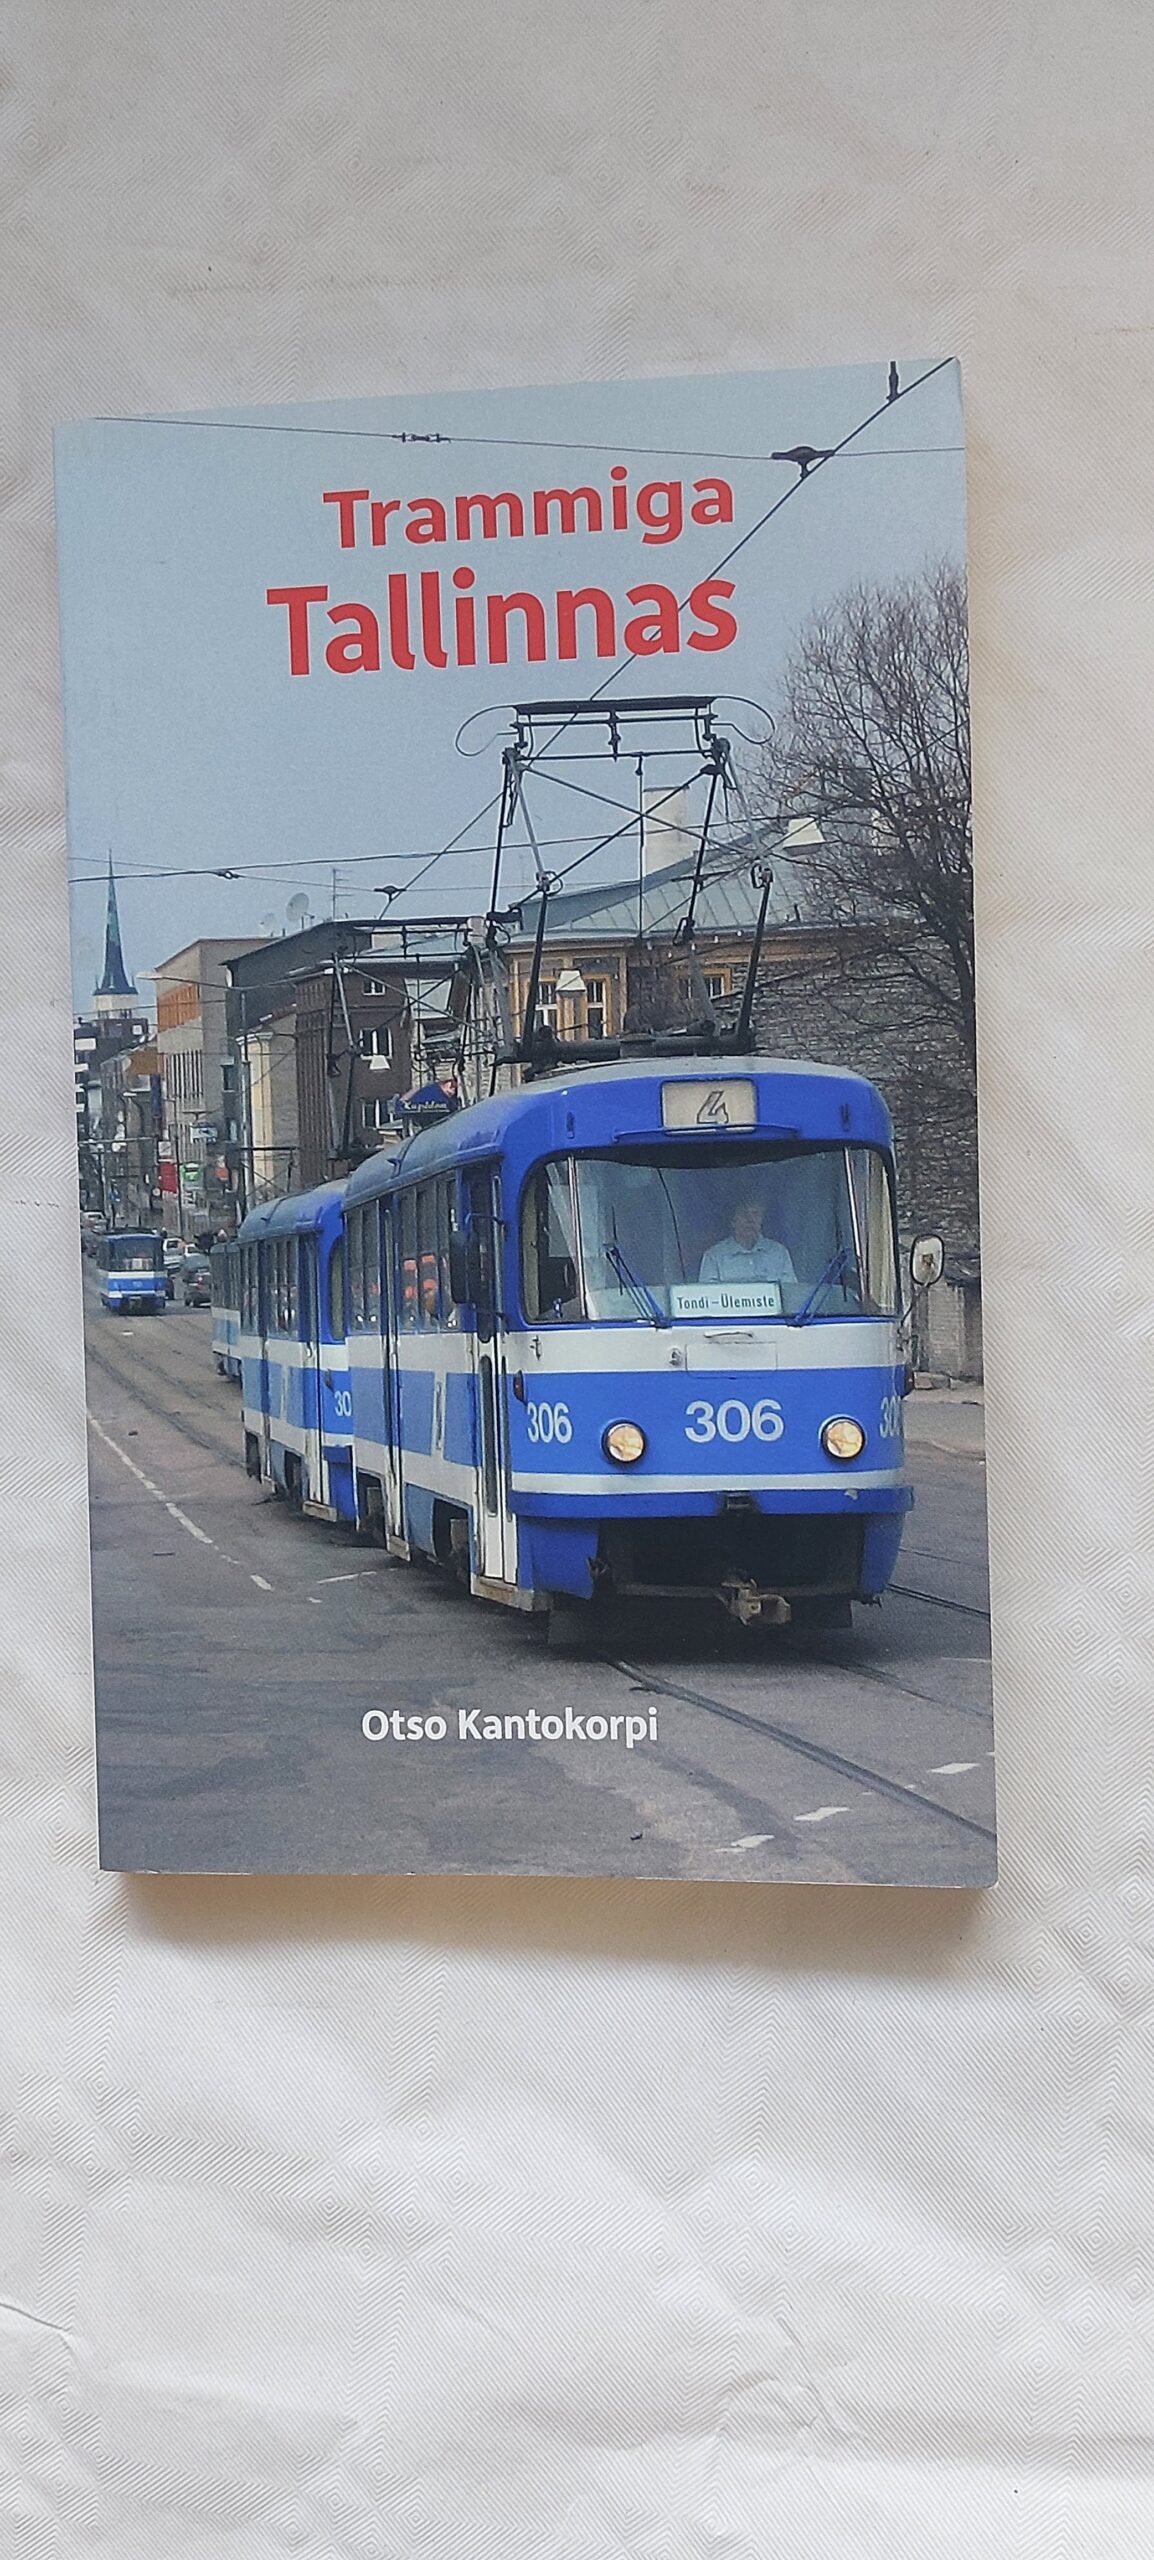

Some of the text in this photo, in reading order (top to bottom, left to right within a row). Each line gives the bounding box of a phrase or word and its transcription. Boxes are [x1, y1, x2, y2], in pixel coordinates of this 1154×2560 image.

[322, 465, 733, 549] Trammiga
[266, 566, 737, 676] Tallinnas
[696, 1090, 729, 1124] 4
[334, 1390, 352, 1417] 30
[527, 1402, 573, 1444] 306
[684, 1399, 784, 1442] 306
[361, 1706, 658, 1749] Otso Kantokorpi
